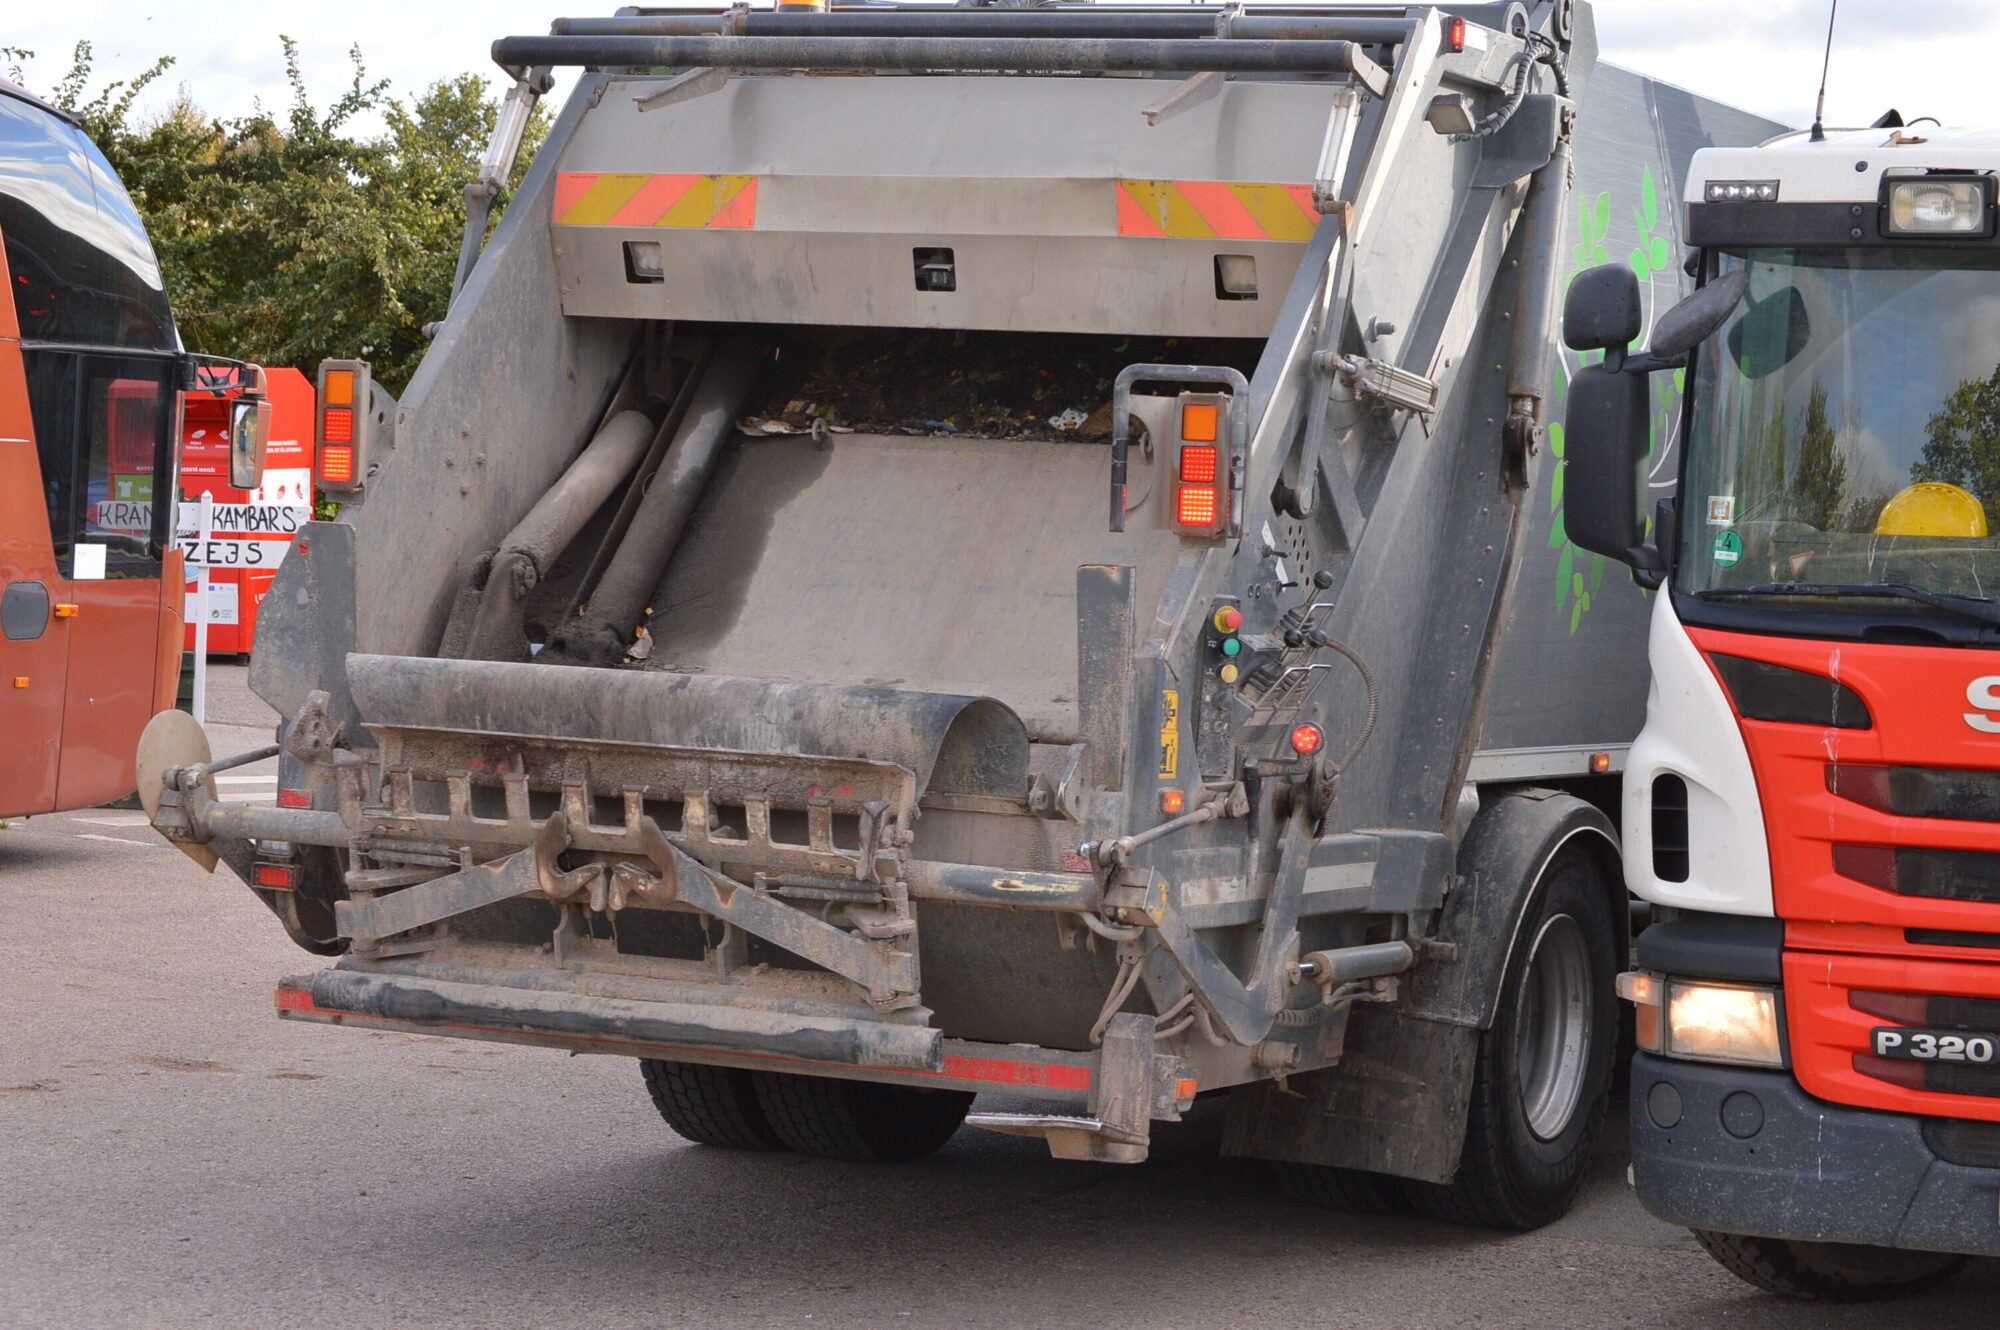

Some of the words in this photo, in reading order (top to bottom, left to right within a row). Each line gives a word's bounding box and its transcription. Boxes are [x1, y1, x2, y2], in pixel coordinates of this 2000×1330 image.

[212, 505, 297, 532] KAMBAR'S
[177, 541, 263, 564] ZEJS
[1877, 1031, 1903, 1055] P
[1910, 1033, 1993, 1062] 320
